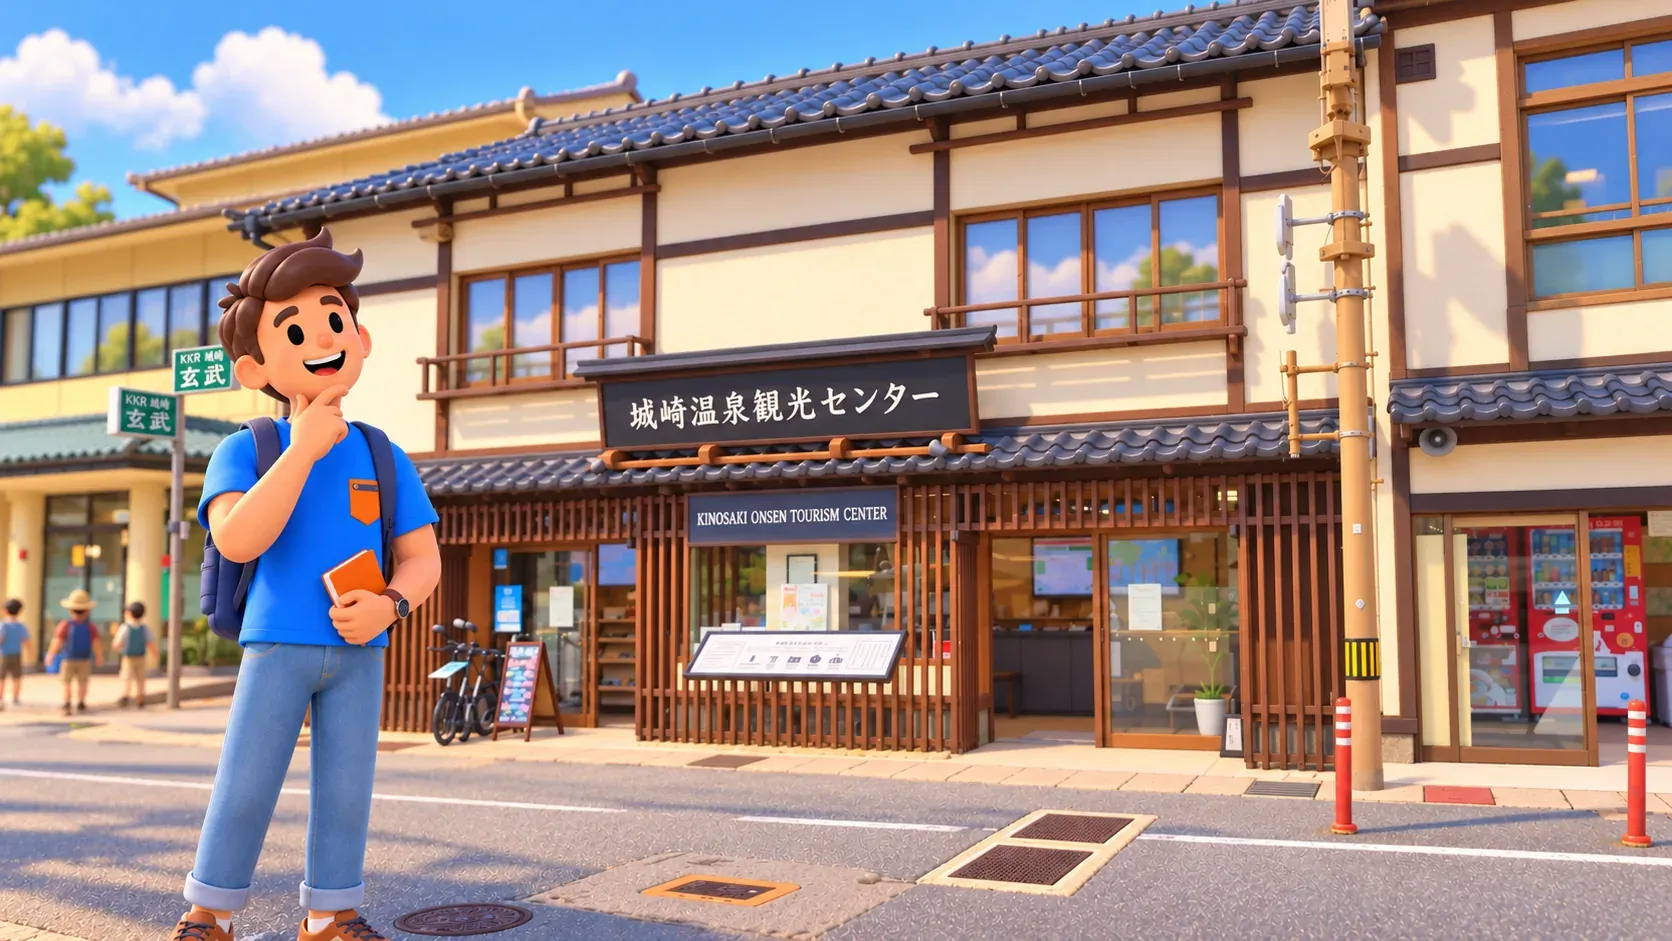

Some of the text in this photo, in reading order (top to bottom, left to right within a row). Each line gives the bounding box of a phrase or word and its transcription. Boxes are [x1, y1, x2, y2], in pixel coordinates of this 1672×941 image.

[180, 353, 201, 364] KKR
[179, 364, 226, 388] 玄武
[126, 395, 147, 407] KKR
[629, 382, 939, 430] 城崎温泉観光センター
[126, 409, 171, 432] 玄武
[696, 506, 888, 526] KINOSAKI ONSEN TOURISM CENTER
